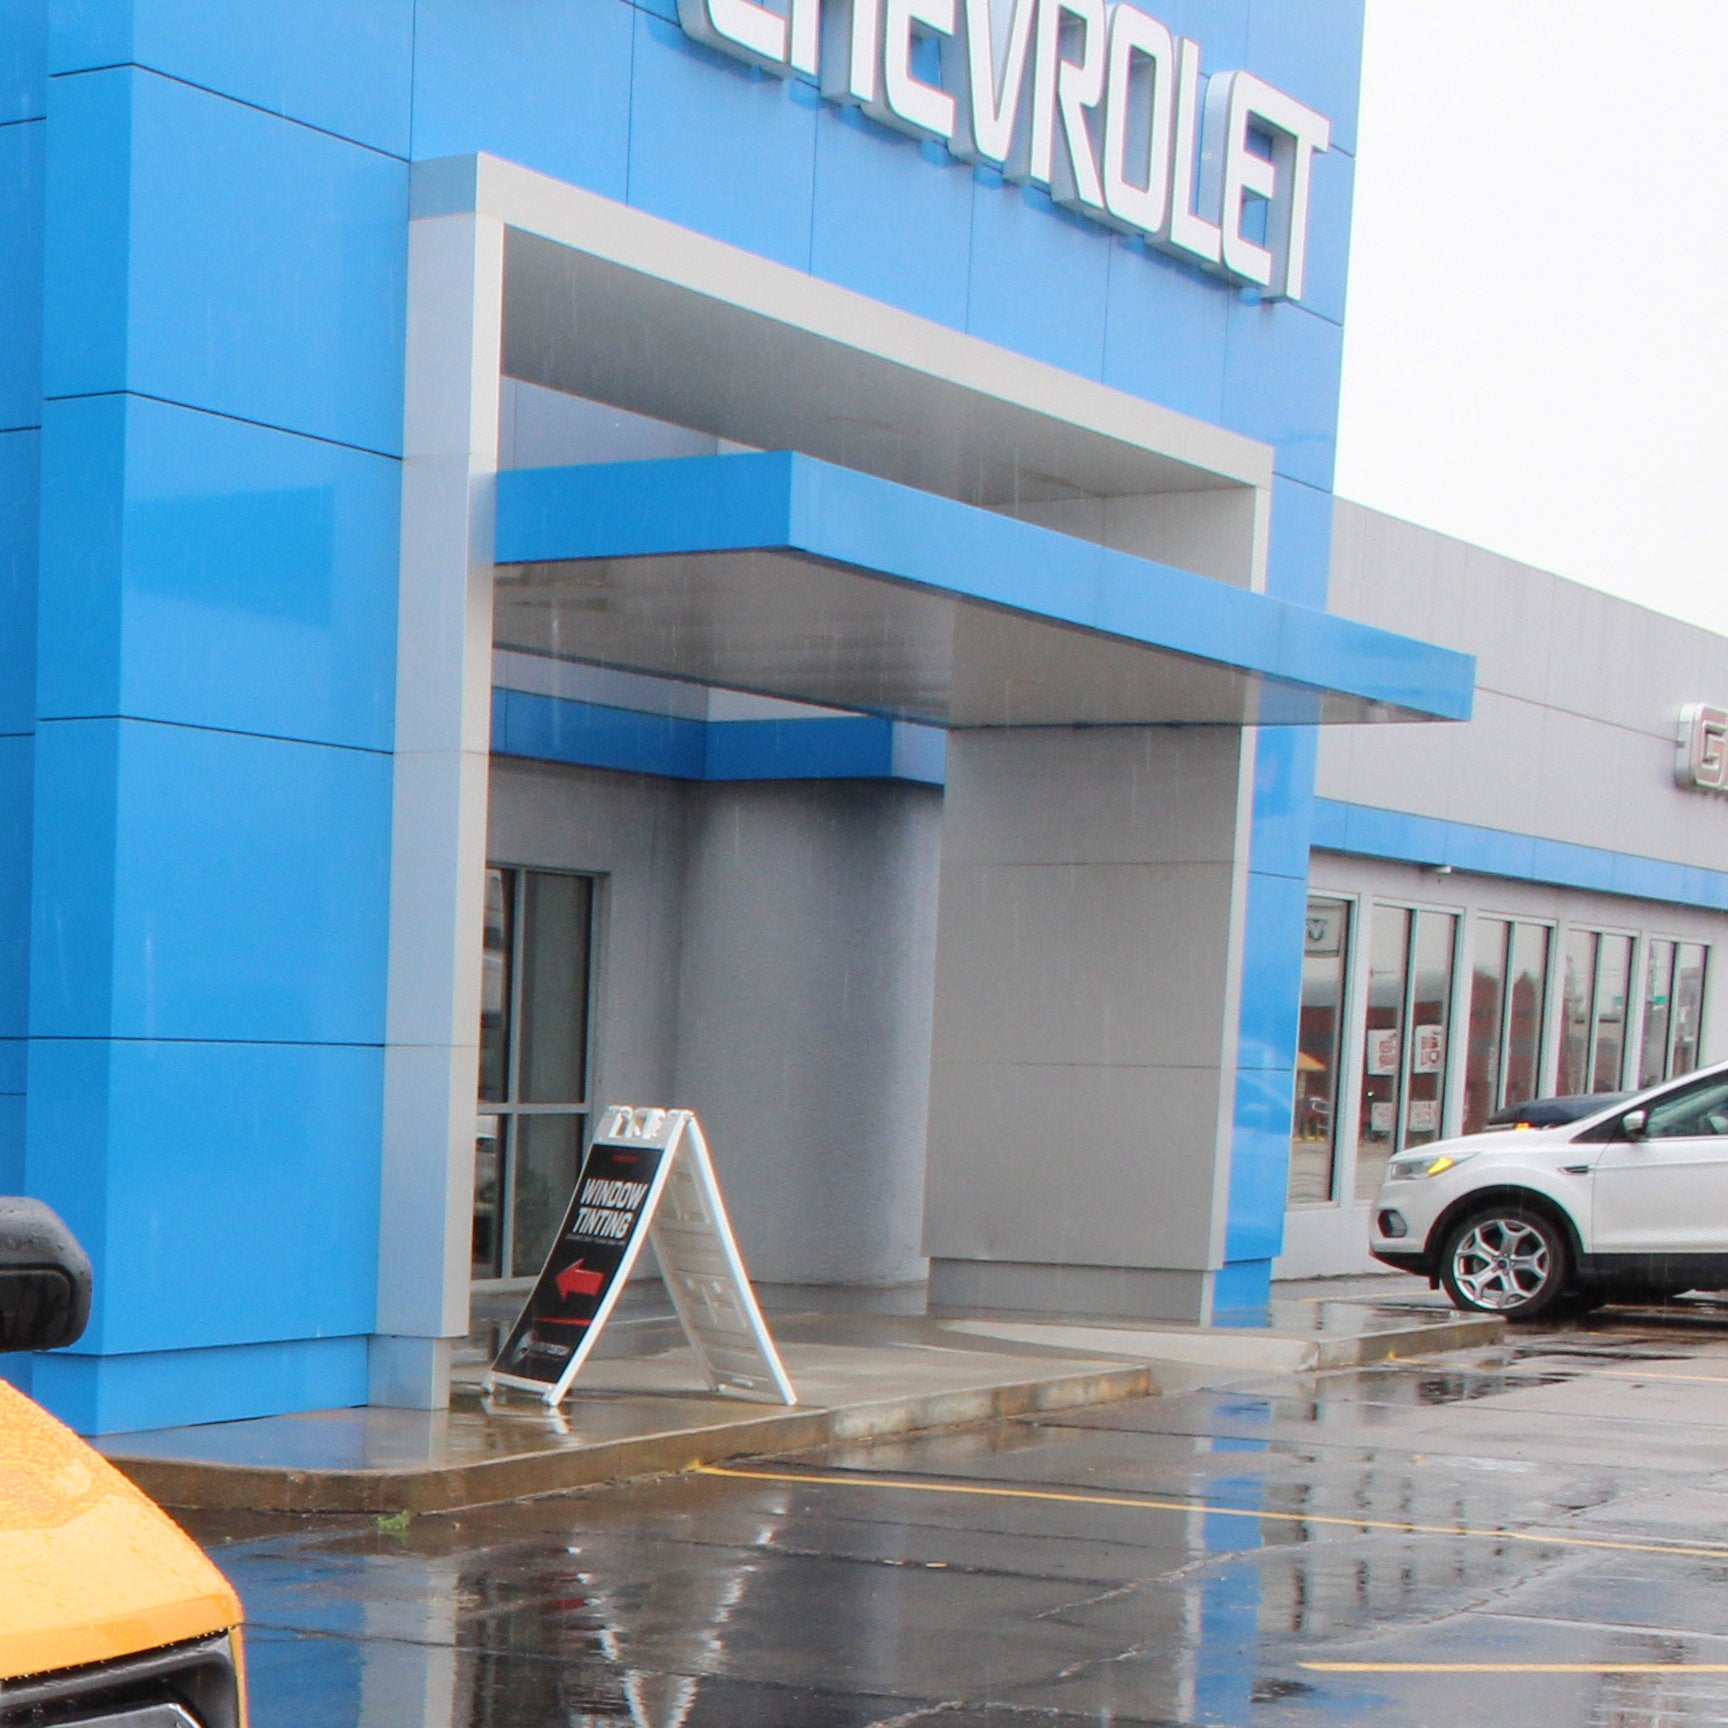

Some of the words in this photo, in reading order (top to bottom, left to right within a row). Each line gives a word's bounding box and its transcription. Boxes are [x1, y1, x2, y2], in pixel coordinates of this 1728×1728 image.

[679, 0, 1330, 303] EVROLET
[580, 1178, 648, 1209] WINDOW
[572, 1207, 633, 1238] TINTING
